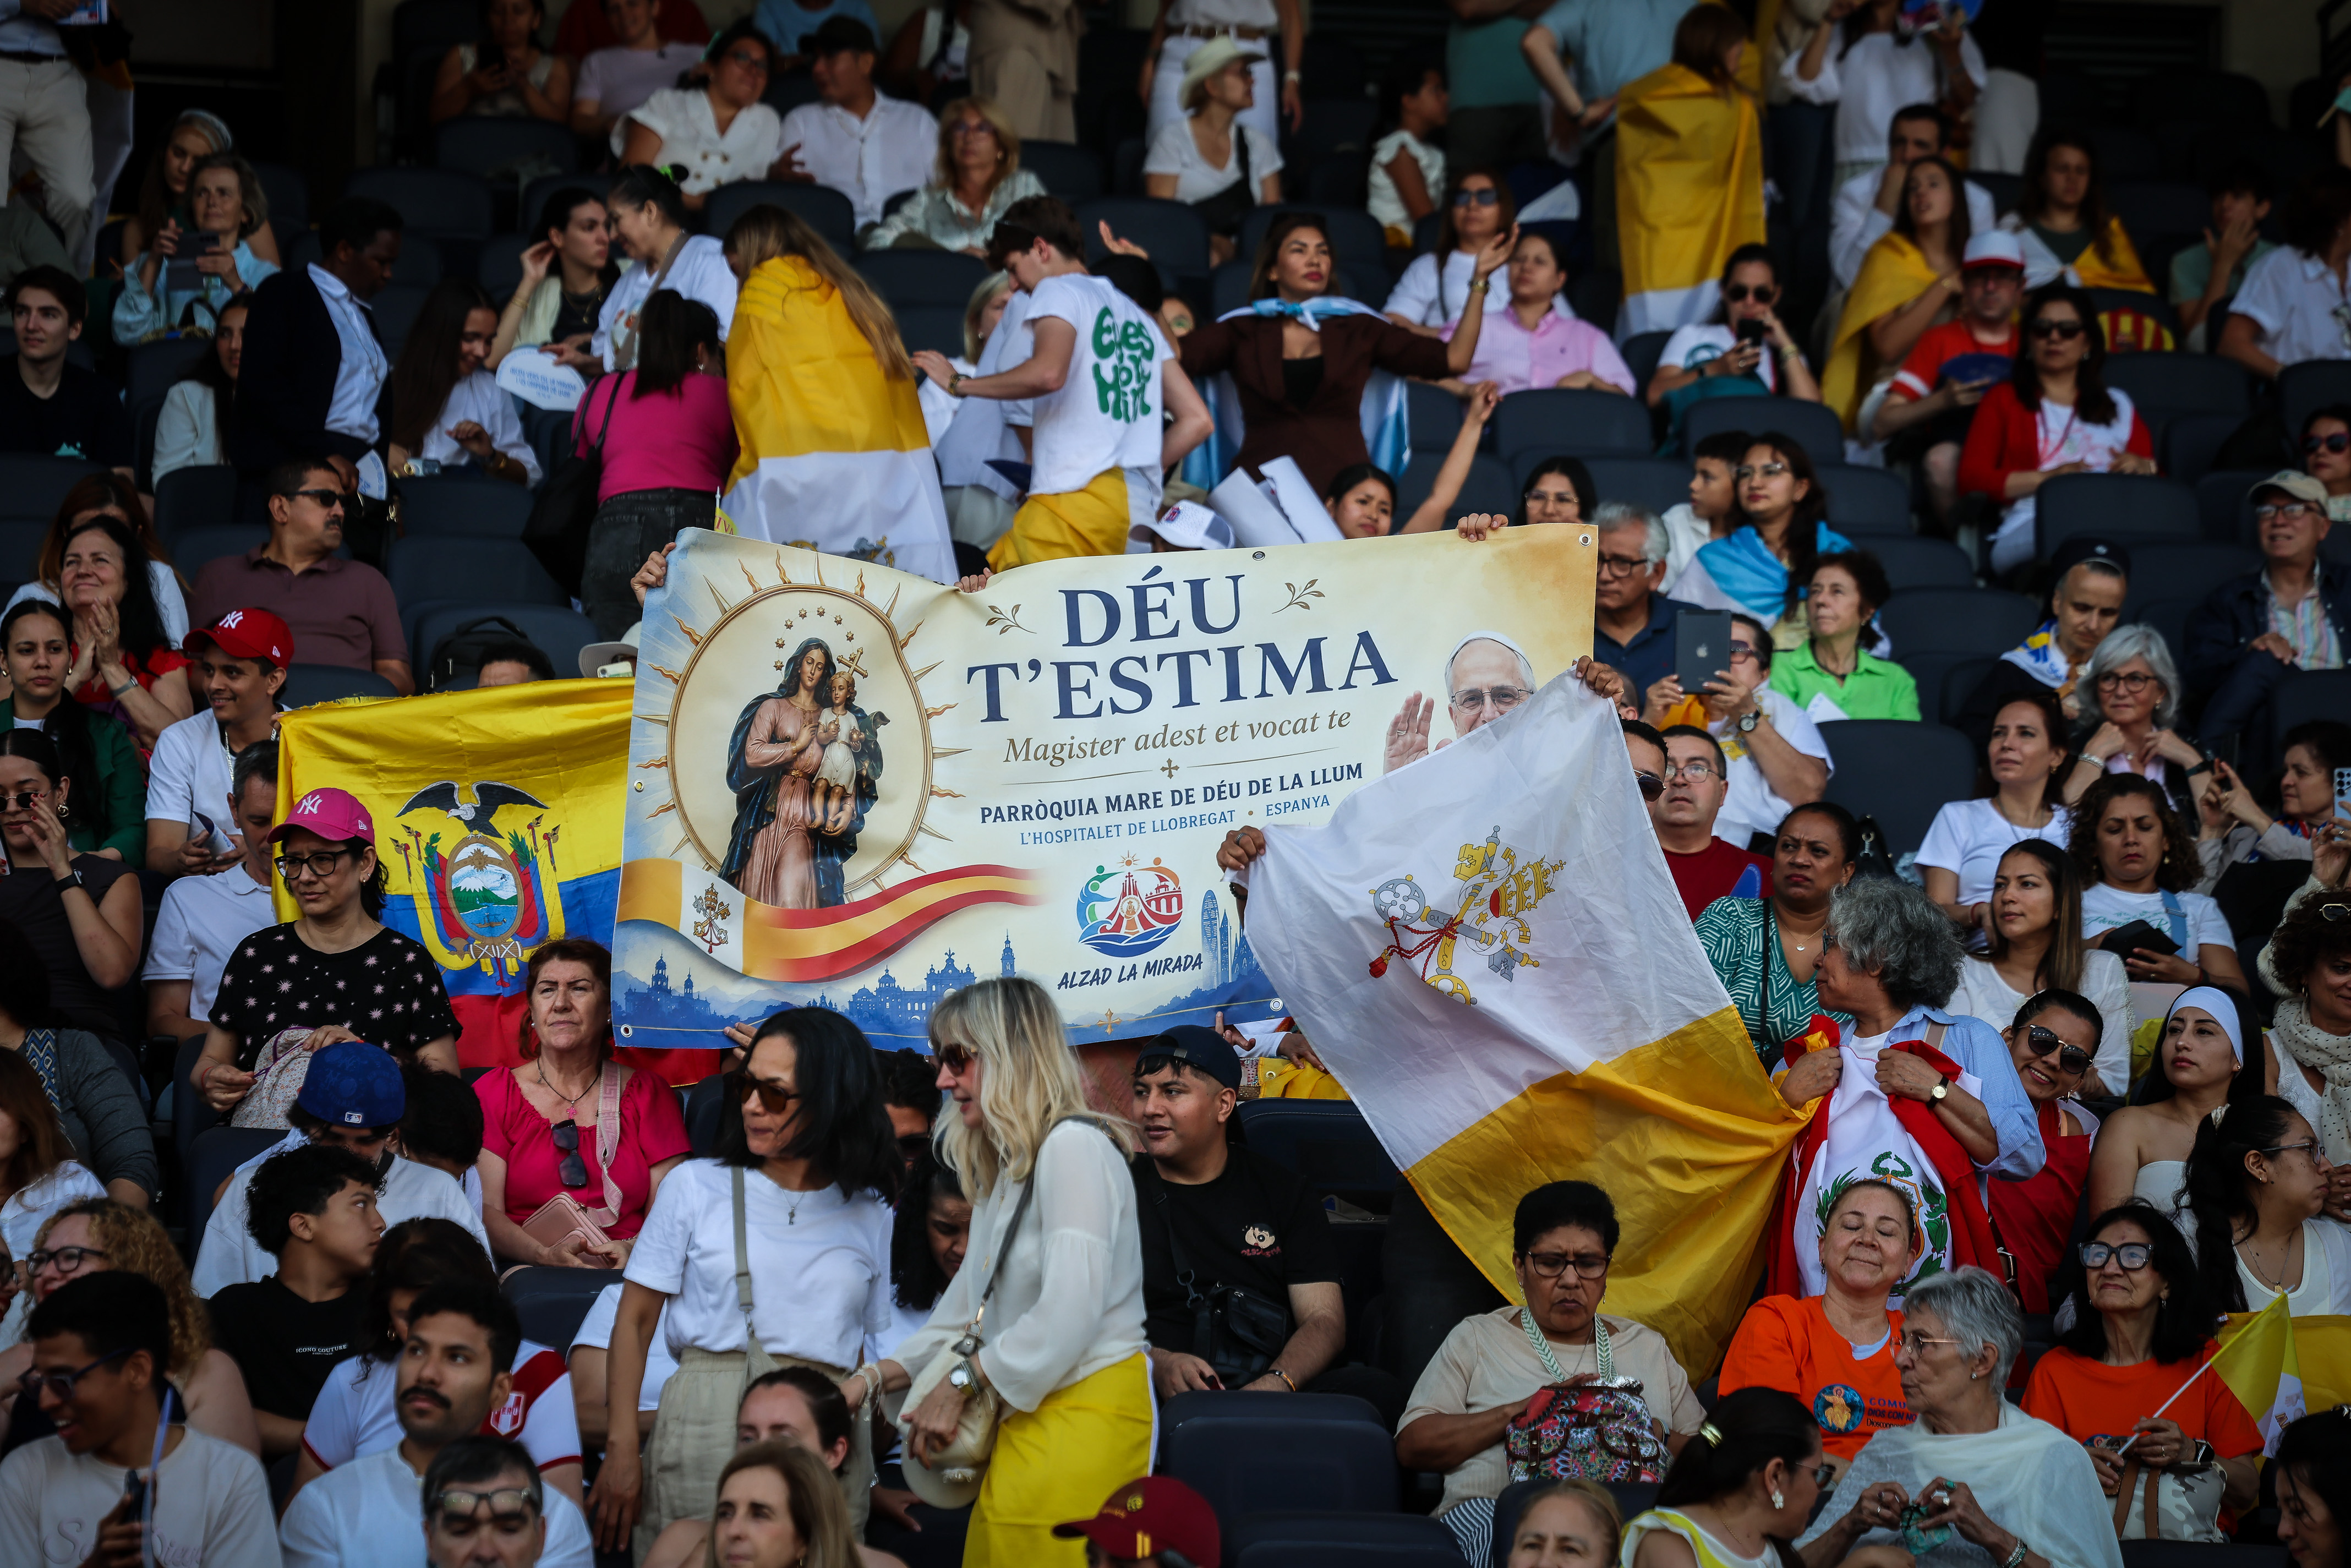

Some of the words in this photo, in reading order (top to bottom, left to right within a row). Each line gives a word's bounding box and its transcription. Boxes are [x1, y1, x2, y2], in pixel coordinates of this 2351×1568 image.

[218, 610, 243, 629] NY
[1058, 565, 1245, 647] DÉU
[967, 630, 1398, 722] T'ESTIMA
[1003, 736, 1126, 767] Magister
[1135, 723, 1207, 751] adest
[1215, 720, 1239, 743] et
[1247, 712, 1320, 740] vocat
[1328, 710, 1351, 730] te
[296, 794, 323, 815] NY
[980, 797, 1098, 823] PARRÒQUIA
[1105, 791, 1163, 813] MARE
[1171, 788, 1195, 807] DE
[1203, 780, 1240, 802] DÉU
[1248, 778, 1272, 796] DE
[1279, 773, 1303, 791] LA
[1310, 762, 1363, 786] LLUM
[1020, 824, 1122, 845] L'HOSPITALET
[1128, 822, 1146, 836] DE
[1152, 810, 1235, 833] LLOBREGAT
[1266, 794, 1330, 817] ESPANYA
[1057, 967, 1112, 990] ALZAD
[1117, 963, 1138, 984] LA
[1142, 953, 1204, 979] MIRADA
[495, 1407, 518, 1416] ERU
[1867, 1408, 1886, 1418] DIOS
[1888, 1411, 1905, 1420] CON
[1905, 1413, 1917, 1423] NO
[1869, 1397, 1906, 1409] COMU
